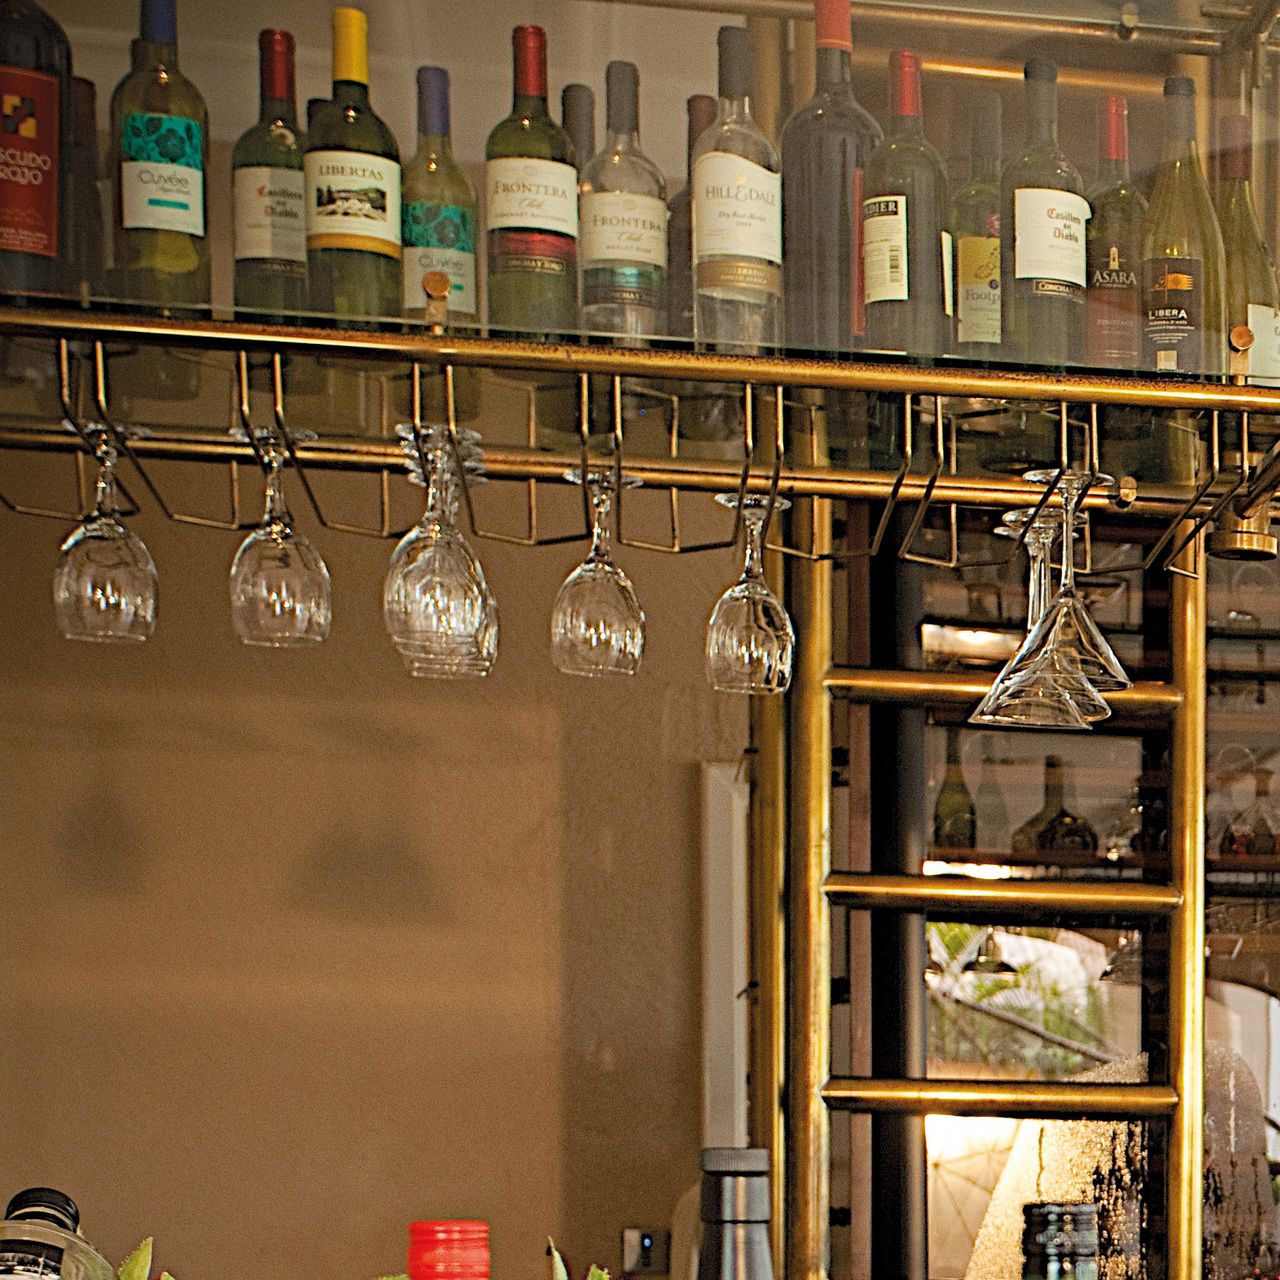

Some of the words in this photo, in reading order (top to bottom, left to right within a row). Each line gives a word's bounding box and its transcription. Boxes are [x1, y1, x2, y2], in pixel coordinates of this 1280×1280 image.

[318, 164, 384, 181] LIBERTAS
[494, 181, 568, 200] FRONTERA
[706, 186, 734, 199] HILL
[749, 188, 776, 206] DALE
[592, 214, 665, 233] FRONTERA
[1094, 270, 1137, 286] ASARA
[1148, 308, 1188, 320] LIBERA
